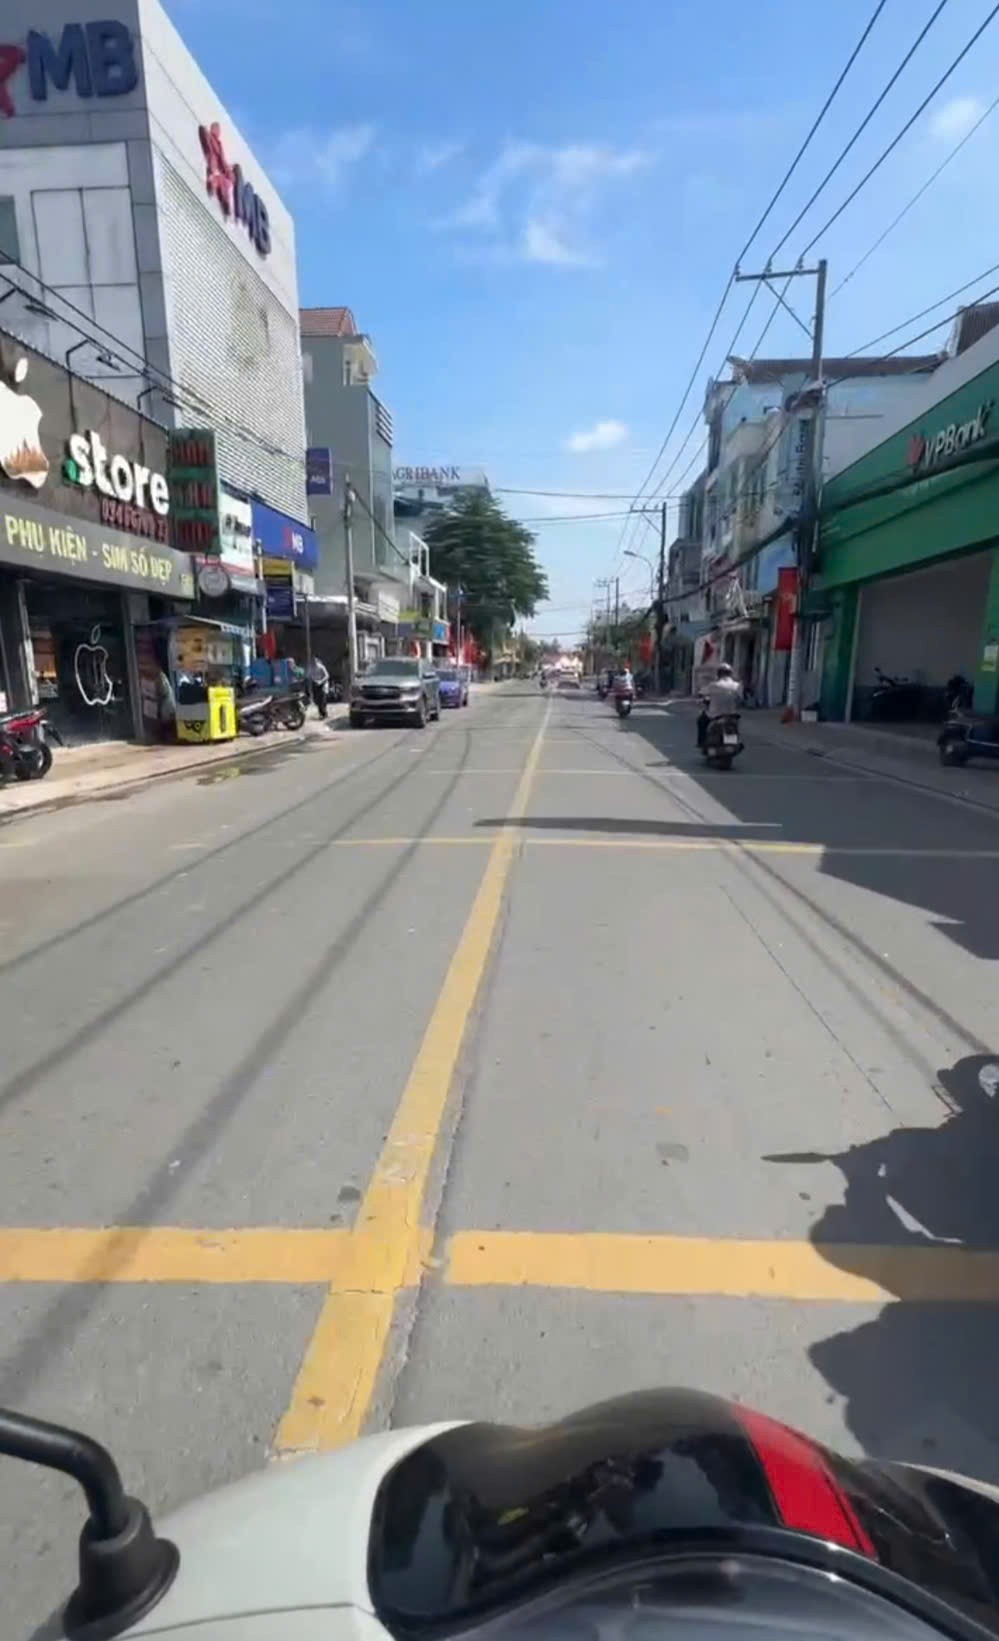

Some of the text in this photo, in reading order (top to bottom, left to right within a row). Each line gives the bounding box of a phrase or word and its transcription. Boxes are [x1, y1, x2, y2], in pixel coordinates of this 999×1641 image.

[26, 20, 138, 101] MB
[924, 405, 987, 467] VPBank
[50, 525, 87, 567] KIỆN
[102, 543, 128, 573] SIM
